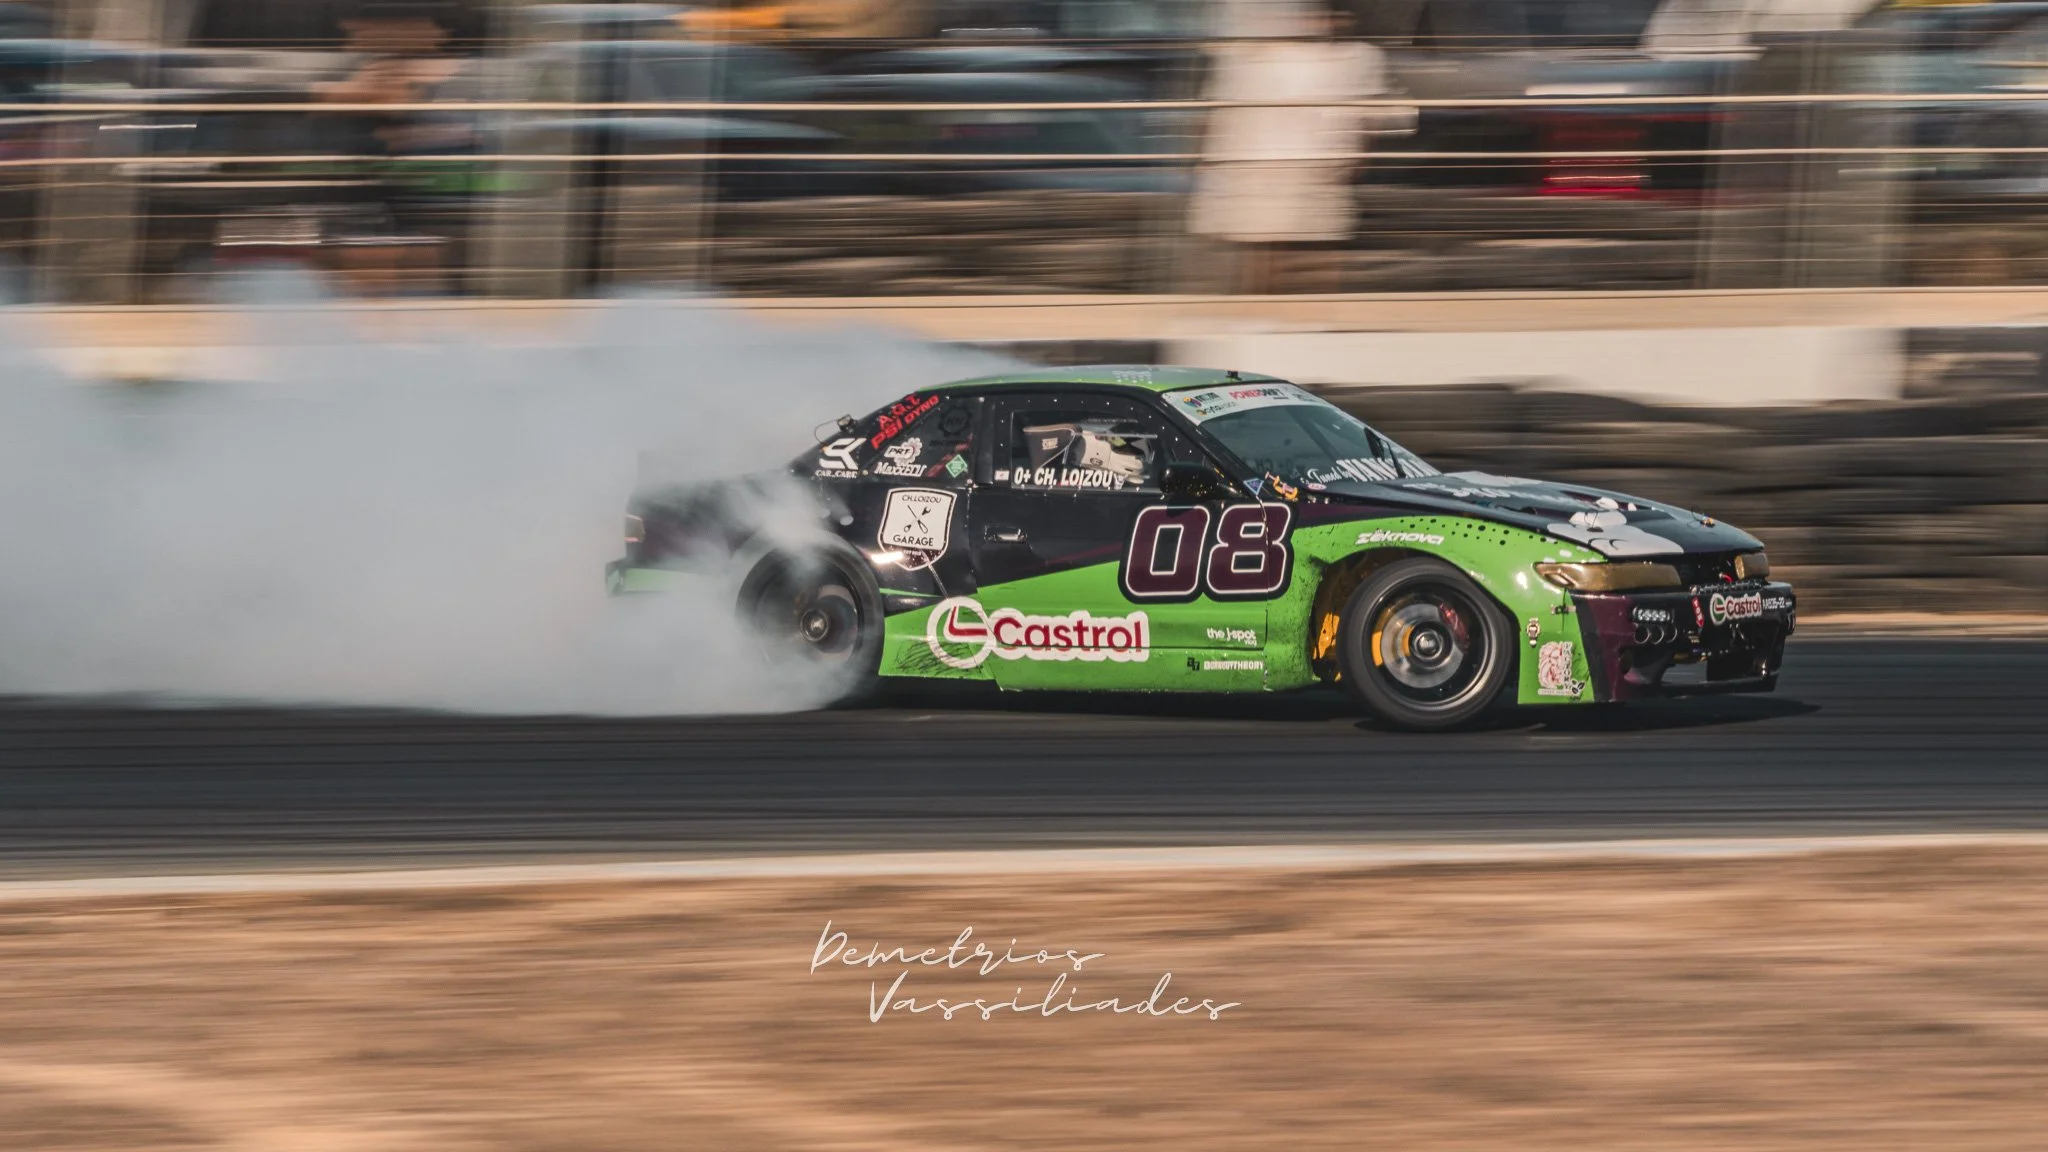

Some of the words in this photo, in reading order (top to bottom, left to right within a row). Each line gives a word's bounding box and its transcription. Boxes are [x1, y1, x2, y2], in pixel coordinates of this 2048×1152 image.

[871, 418, 903, 449] PSI
[904, 394, 940, 424] DYNO
[1061, 467, 1114, 488] LOIZOU
[893, 534, 934, 547] GARAGE
[1125, 502, 1291, 597] 08
[1725, 595, 1762, 617] Castrol
[993, 616, 1143, 653] Castrol
[1207, 627, 1226, 640] the
